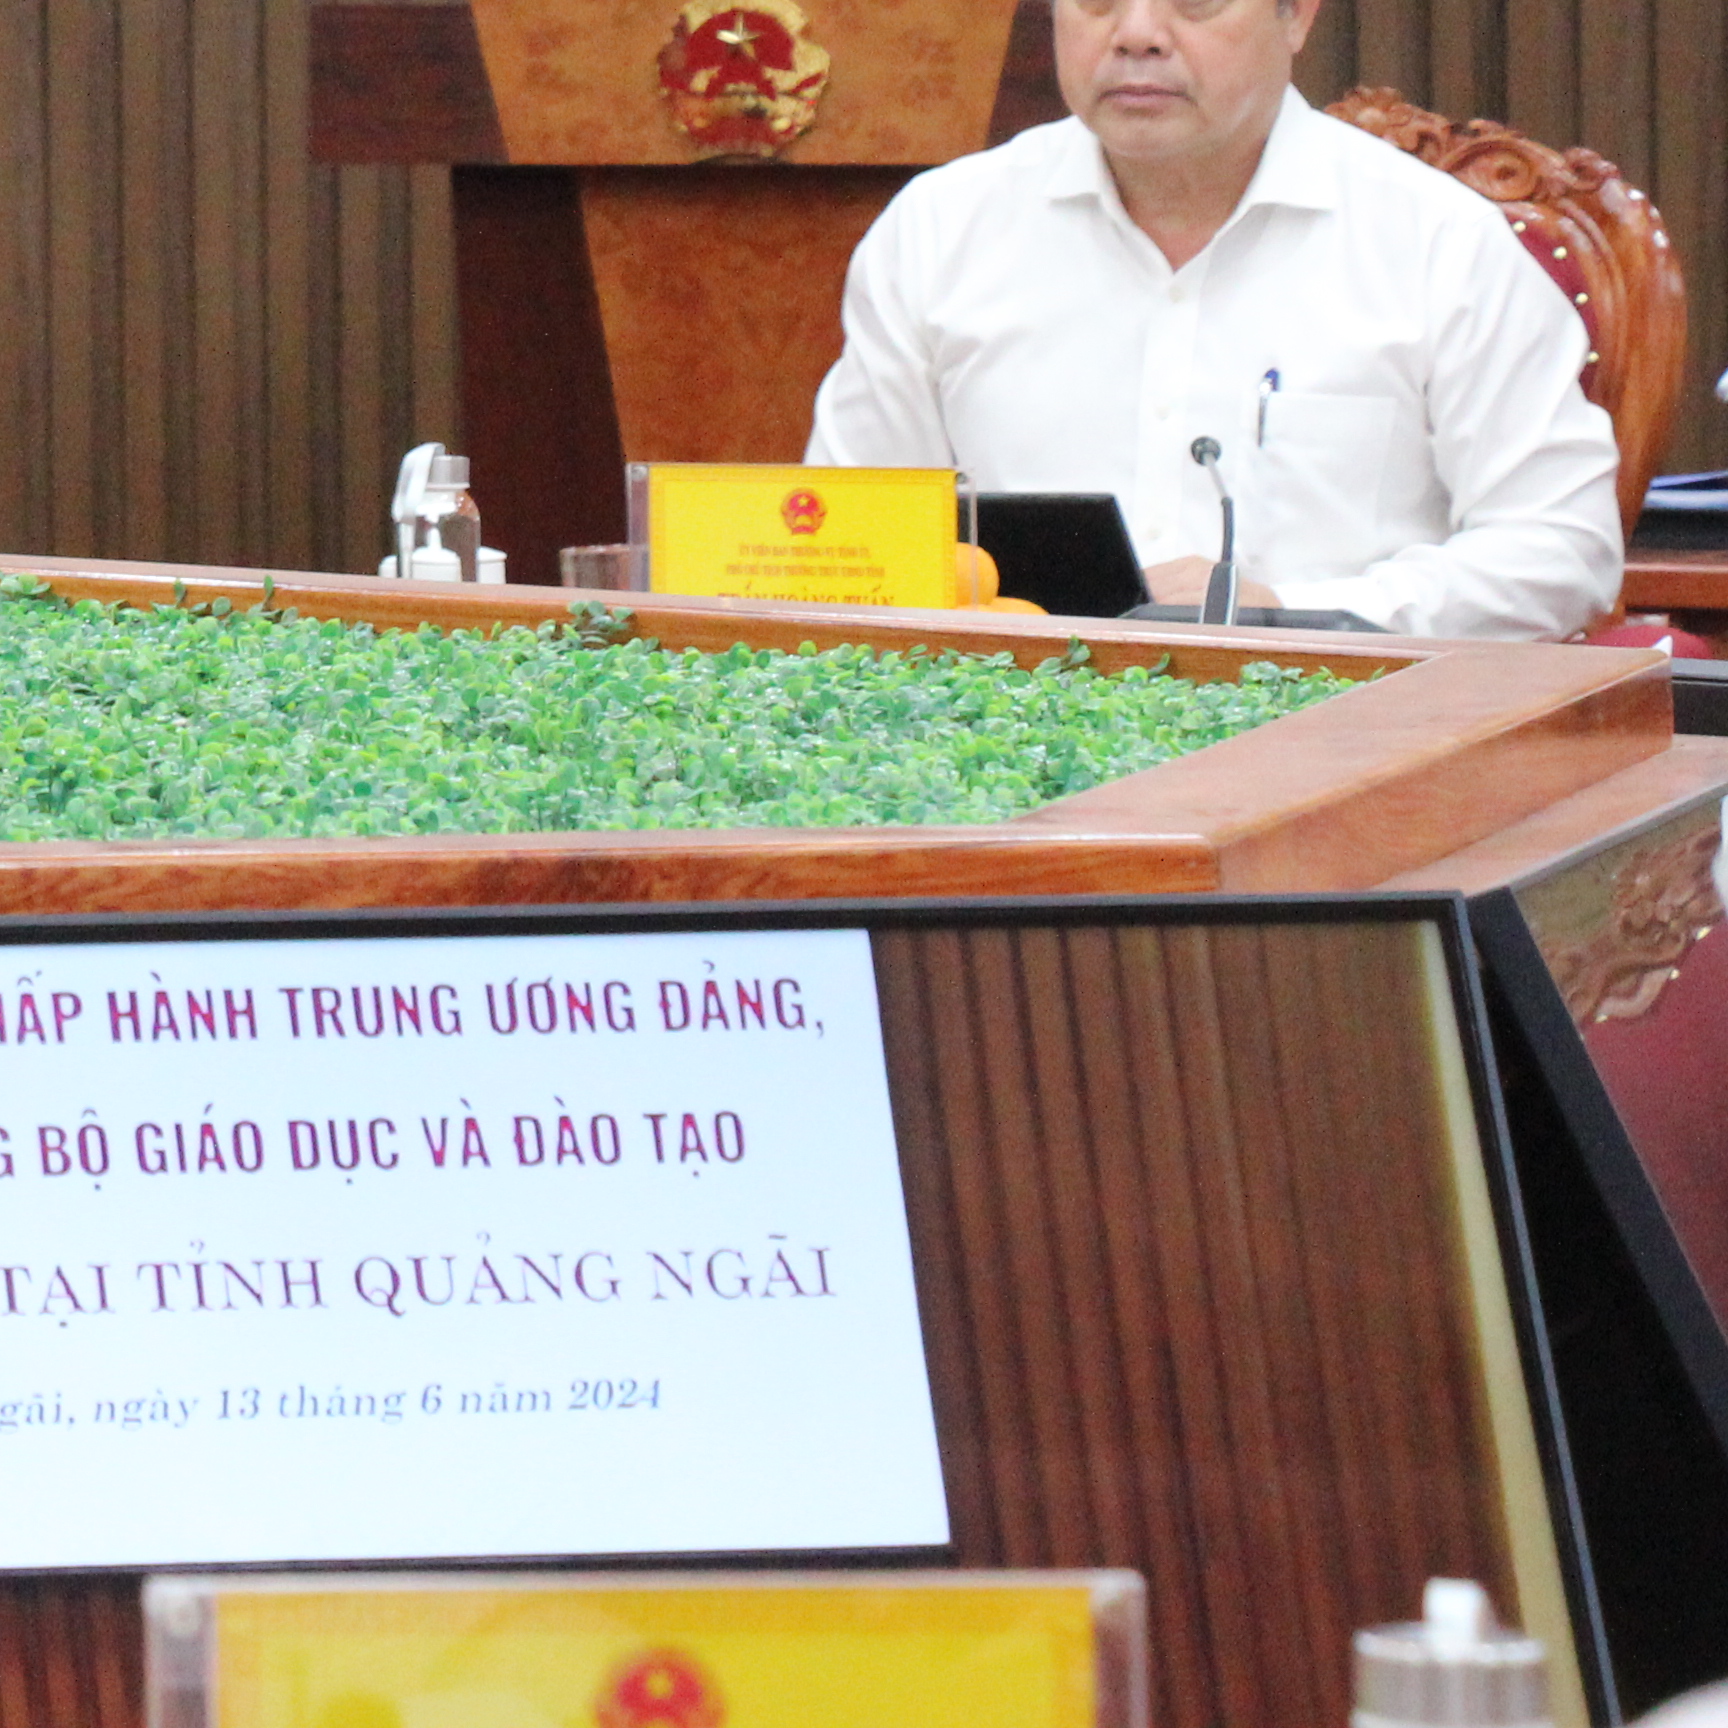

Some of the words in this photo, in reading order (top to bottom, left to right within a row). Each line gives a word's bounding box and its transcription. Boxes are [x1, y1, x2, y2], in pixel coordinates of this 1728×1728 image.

[107, 971, 259, 1042] HÀNH
[279, 984, 463, 1039] TRUNG
[485, 975, 637, 1034] ƯƠNG
[659, 960, 825, 1039] ĐẢNG,
[38, 1109, 111, 1190] BỘ
[134, 1104, 265, 1175] GIÁO
[288, 1118, 400, 1185] DỤC
[421, 1098, 491, 1168] VÀ
[513, 1096, 623, 1166] ĐÀO
[644, 1111, 747, 1178] TẠO
[137, 1239, 328, 1312] TỈNH
[354, 1232, 622, 1317] QUẢNG
[647, 1234, 837, 1299] NGÃI
[93, 1387, 200, 1431] ngày
[216, 1385, 261, 1419] 13
[279, 1383, 406, 1424] tháng
[421, 1382, 443, 1415] 6
[459, 1382, 553, 1413] năm
[567, 1377, 662, 1411] 2024
